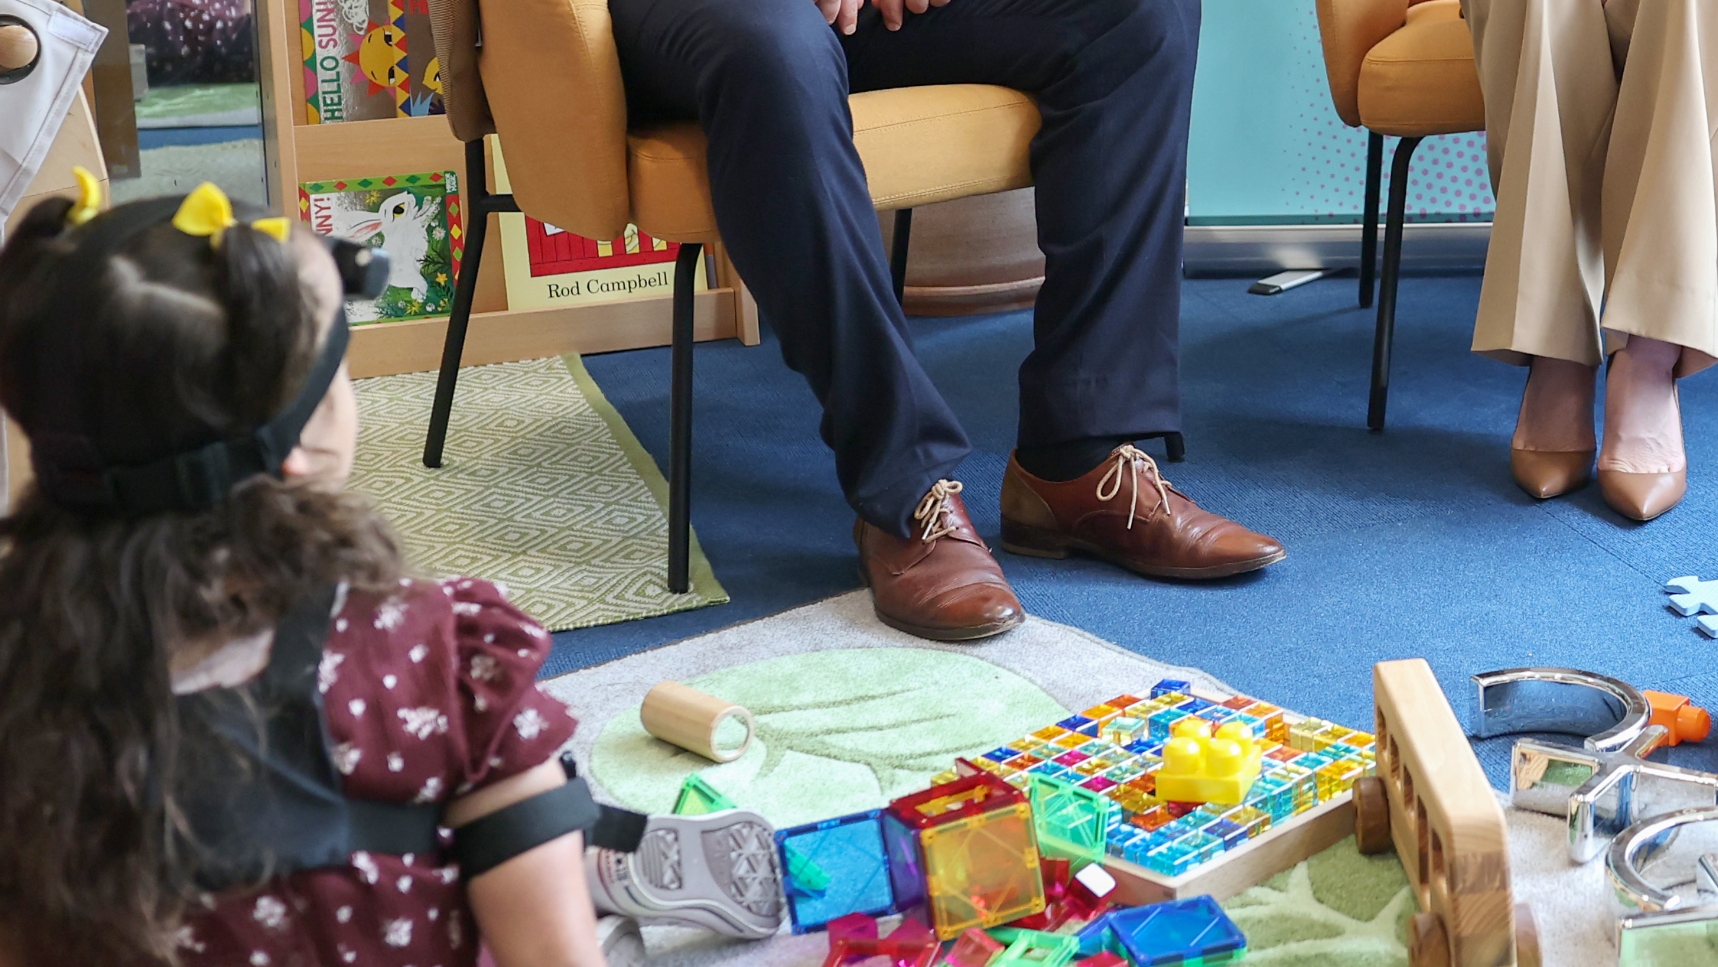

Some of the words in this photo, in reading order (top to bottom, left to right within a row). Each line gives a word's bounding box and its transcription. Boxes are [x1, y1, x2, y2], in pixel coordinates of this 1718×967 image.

[315, 1, 338, 49] SUN!
[319, 55, 344, 121] HELLO
[547, 282, 581, 299] Rod
[586, 271, 669, 295] Campbell
